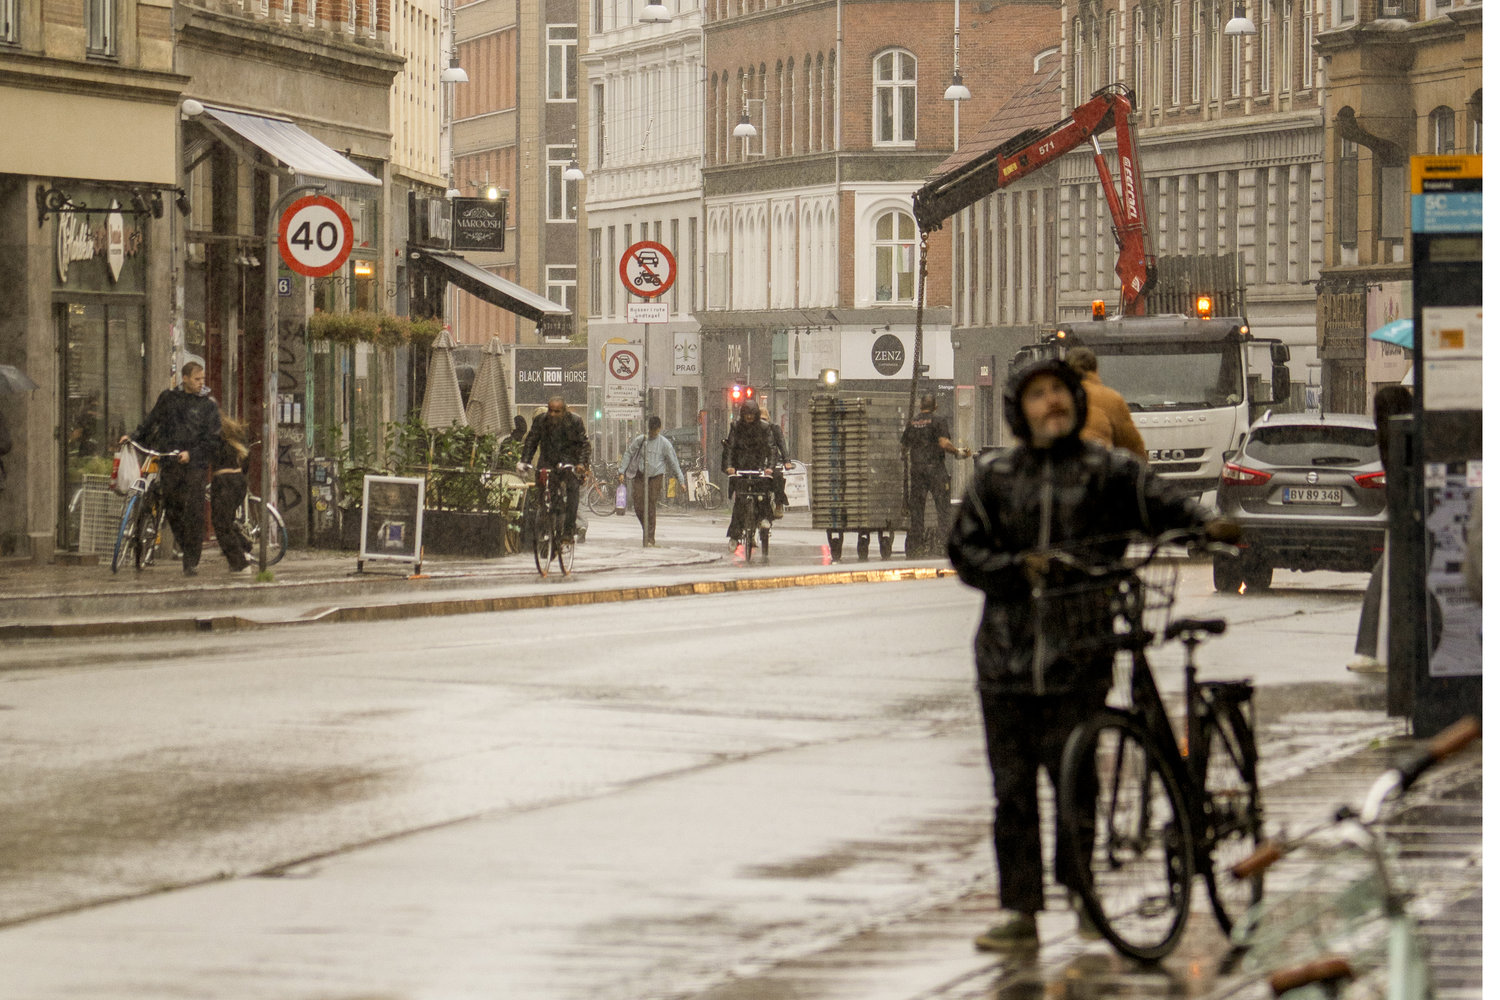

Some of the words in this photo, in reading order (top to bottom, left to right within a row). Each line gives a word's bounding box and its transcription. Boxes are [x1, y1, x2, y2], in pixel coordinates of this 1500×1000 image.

[1039, 141, 1055, 155] 571
[1425, 194, 1447, 210] 5C
[457, 219, 502, 229] MAROOSH
[290, 221, 338, 251] 40
[728, 344, 741, 373] PRAG
[875, 350, 902, 361] ZENZ
[676, 364, 696, 372] PRAG
[519, 370, 541, 382] BLACK
[543, 370, 562, 382] IRON
[564, 370, 587, 383] HORSE
[1139, 416, 1207, 424] OCARGO
[1148, 449, 1185, 461] ECO
[1290, 490, 1304, 500] BV
[1306, 490, 1319, 500] 89
[1321, 490, 1340, 500] 348
